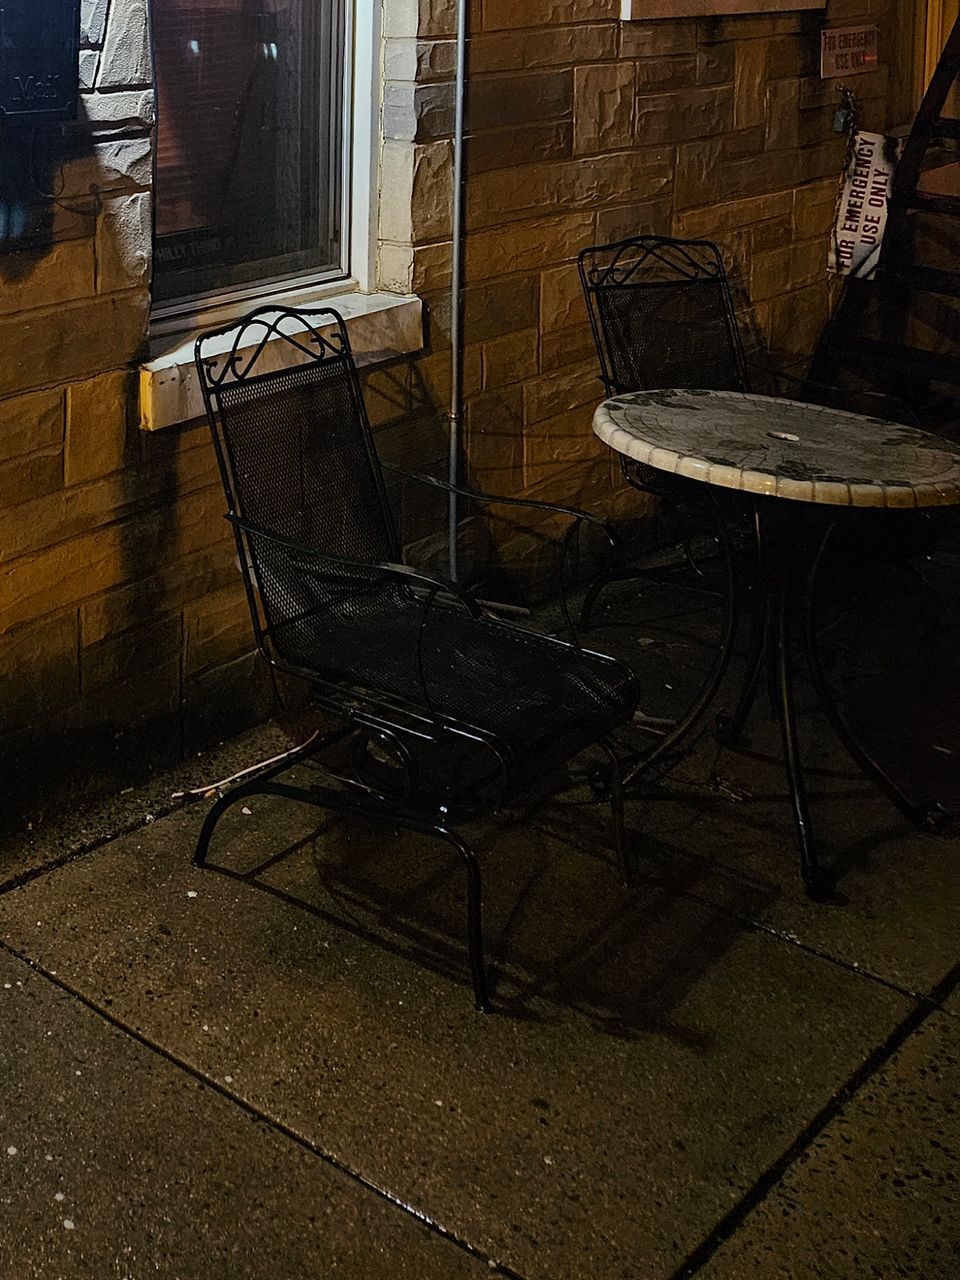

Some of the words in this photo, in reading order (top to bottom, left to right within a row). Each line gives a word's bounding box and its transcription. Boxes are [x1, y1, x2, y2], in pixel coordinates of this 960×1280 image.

[841, 137, 876, 233] EMERGENCY
[868, 168, 890, 208] ONLY
[860, 214, 881, 246] USE
